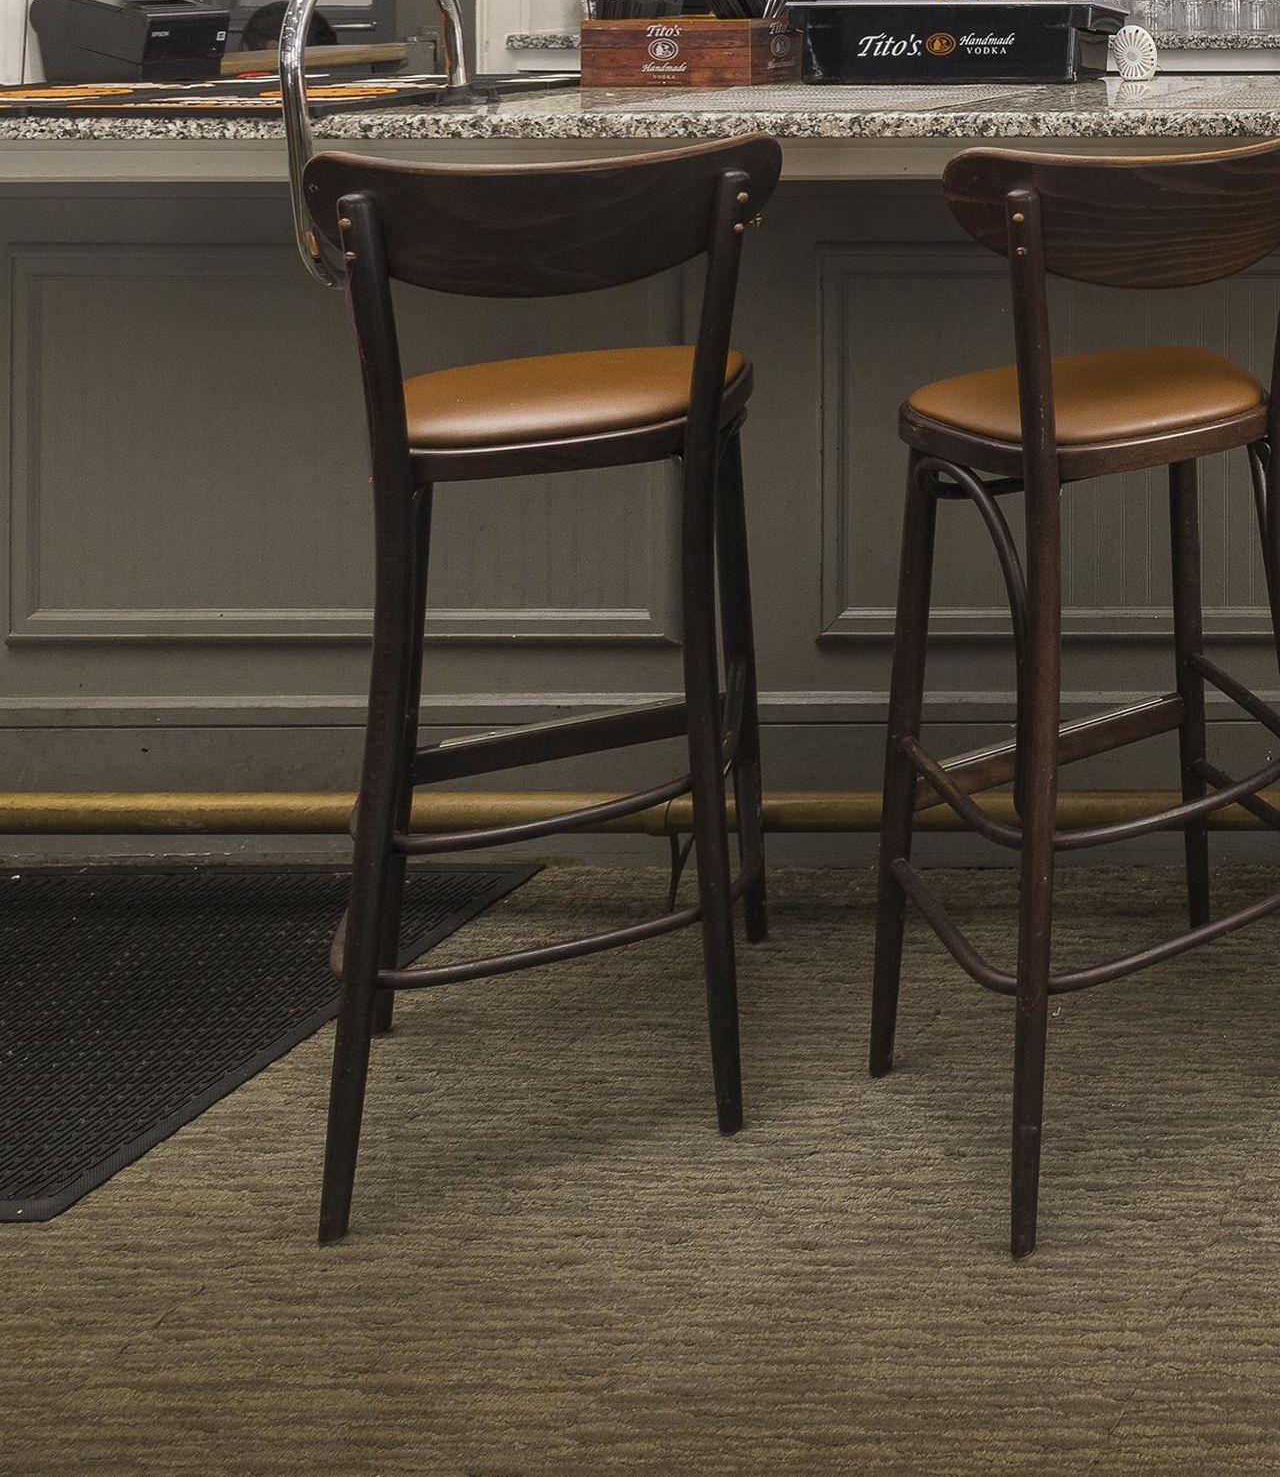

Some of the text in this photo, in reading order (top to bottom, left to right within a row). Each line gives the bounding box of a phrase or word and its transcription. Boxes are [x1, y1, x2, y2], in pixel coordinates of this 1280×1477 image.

[646, 24, 682, 37] Tito's
[857, 32, 923, 57] Tito's
[959, 33, 1015, 46] Handmade
[966, 47, 1008, 55] VODKA
[641, 61, 688, 73] Handmade
